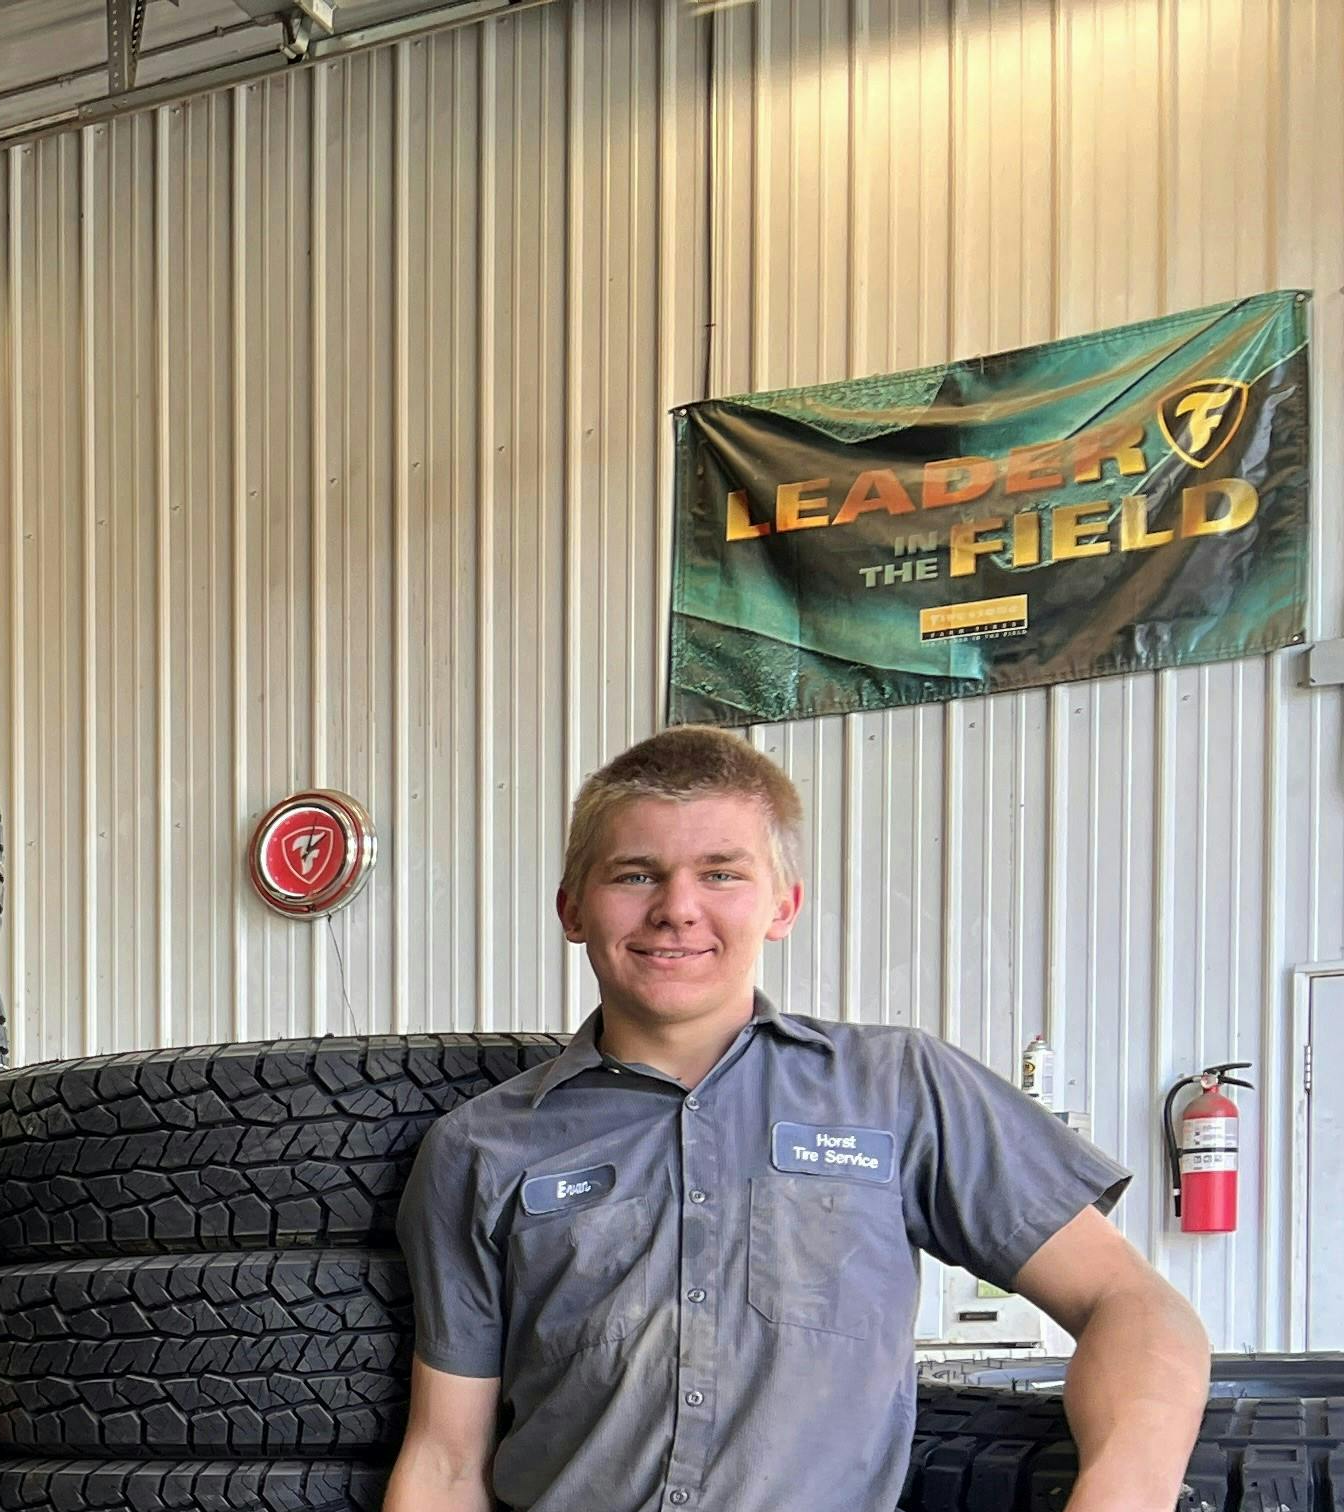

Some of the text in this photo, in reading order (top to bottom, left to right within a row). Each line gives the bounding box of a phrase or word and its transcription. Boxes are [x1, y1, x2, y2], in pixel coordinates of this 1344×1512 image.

[726, 422, 1148, 542] LEADER
[949, 478, 1260, 578] FIELD
[895, 530, 938, 557] IN
[859, 557, 939, 588] THE
[816, 1132, 857, 1150] Horst
[792, 1145, 879, 1170] Tire Service
